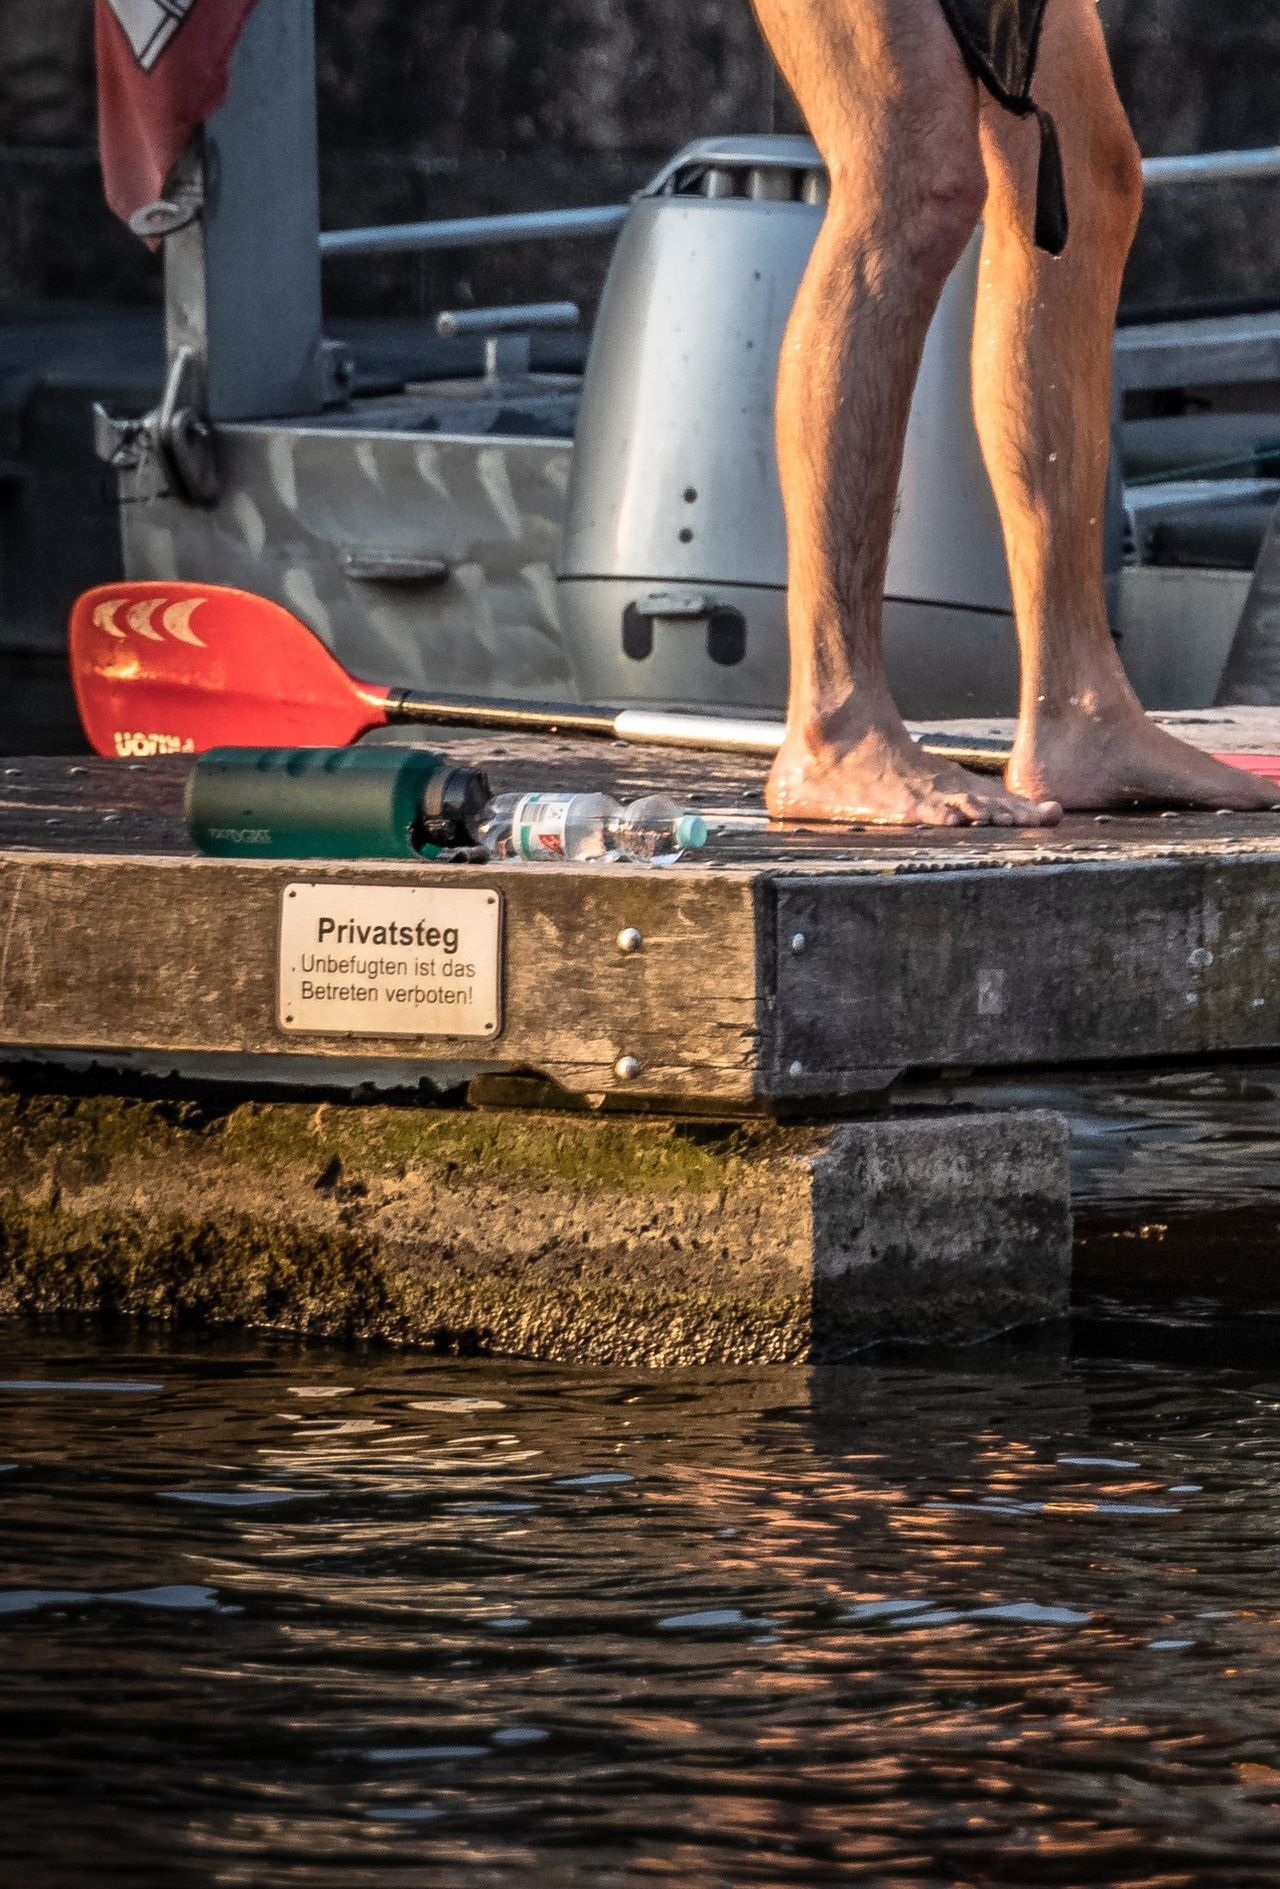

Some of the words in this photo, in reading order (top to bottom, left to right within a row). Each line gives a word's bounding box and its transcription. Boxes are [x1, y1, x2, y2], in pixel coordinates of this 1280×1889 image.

[317, 917, 460, 954] Privatsteg
[301, 954, 407, 979] Unbefugten
[414, 957, 435, 976] ist
[442, 959, 476, 978] das
[301, 980, 379, 1002] Betreten
[385, 985, 473, 1005] verboten!
